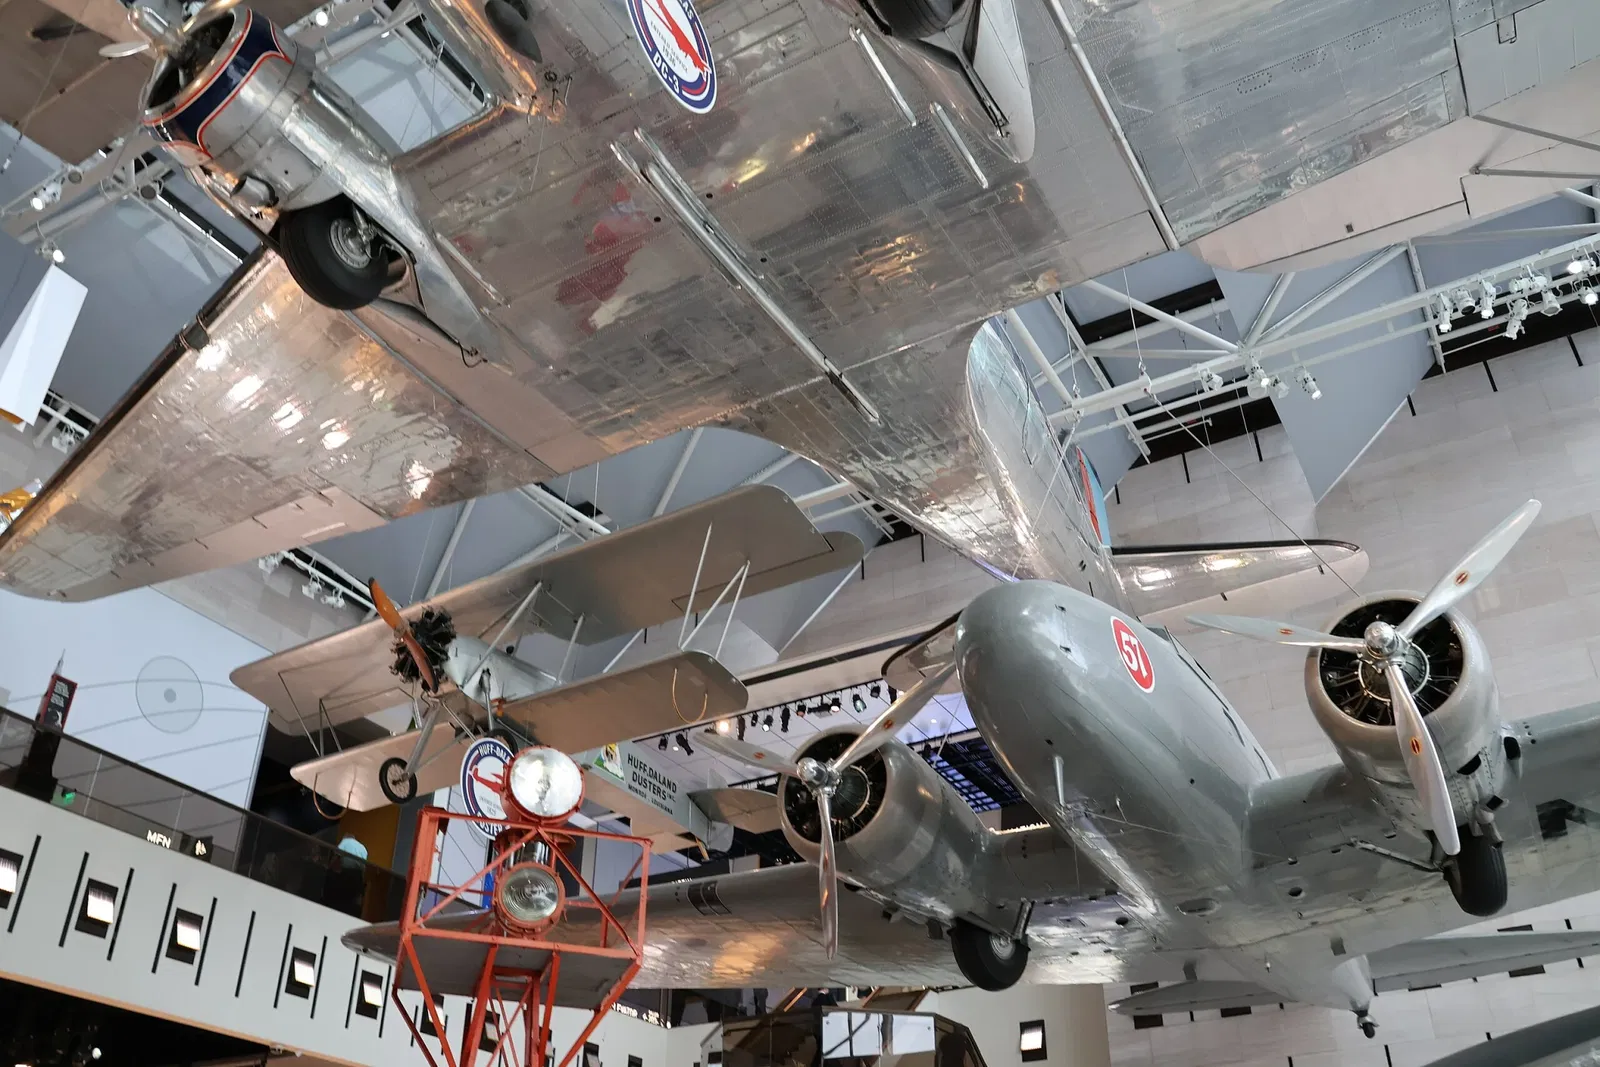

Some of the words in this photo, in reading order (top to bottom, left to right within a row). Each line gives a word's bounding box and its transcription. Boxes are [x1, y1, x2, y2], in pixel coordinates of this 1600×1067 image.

[653, 51, 680, 94] DC-3
[1120, 630, 1148, 679] 57
[632, 770, 667, 801] DUSTERS
